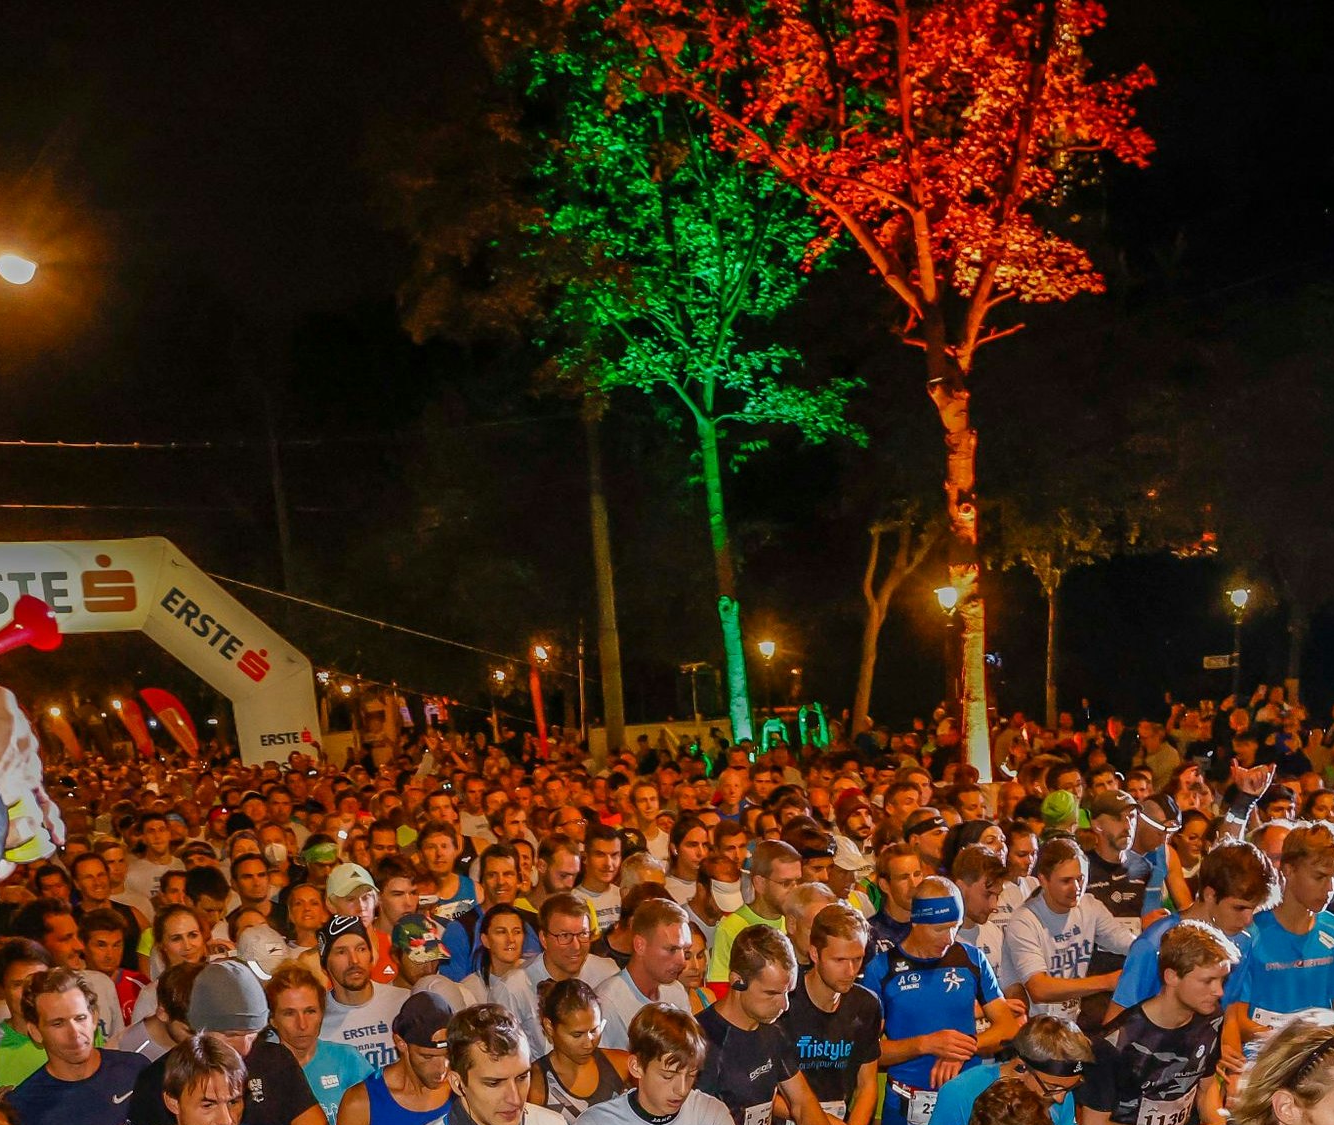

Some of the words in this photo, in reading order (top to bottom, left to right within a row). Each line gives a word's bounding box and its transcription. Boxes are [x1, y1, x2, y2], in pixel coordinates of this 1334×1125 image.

[160, 587, 244, 661] ERSTE
[260, 731, 300, 747] ERSTE
[343, 1025, 377, 1041] ERSTE
[797, 1036, 853, 1060] Tristyle
